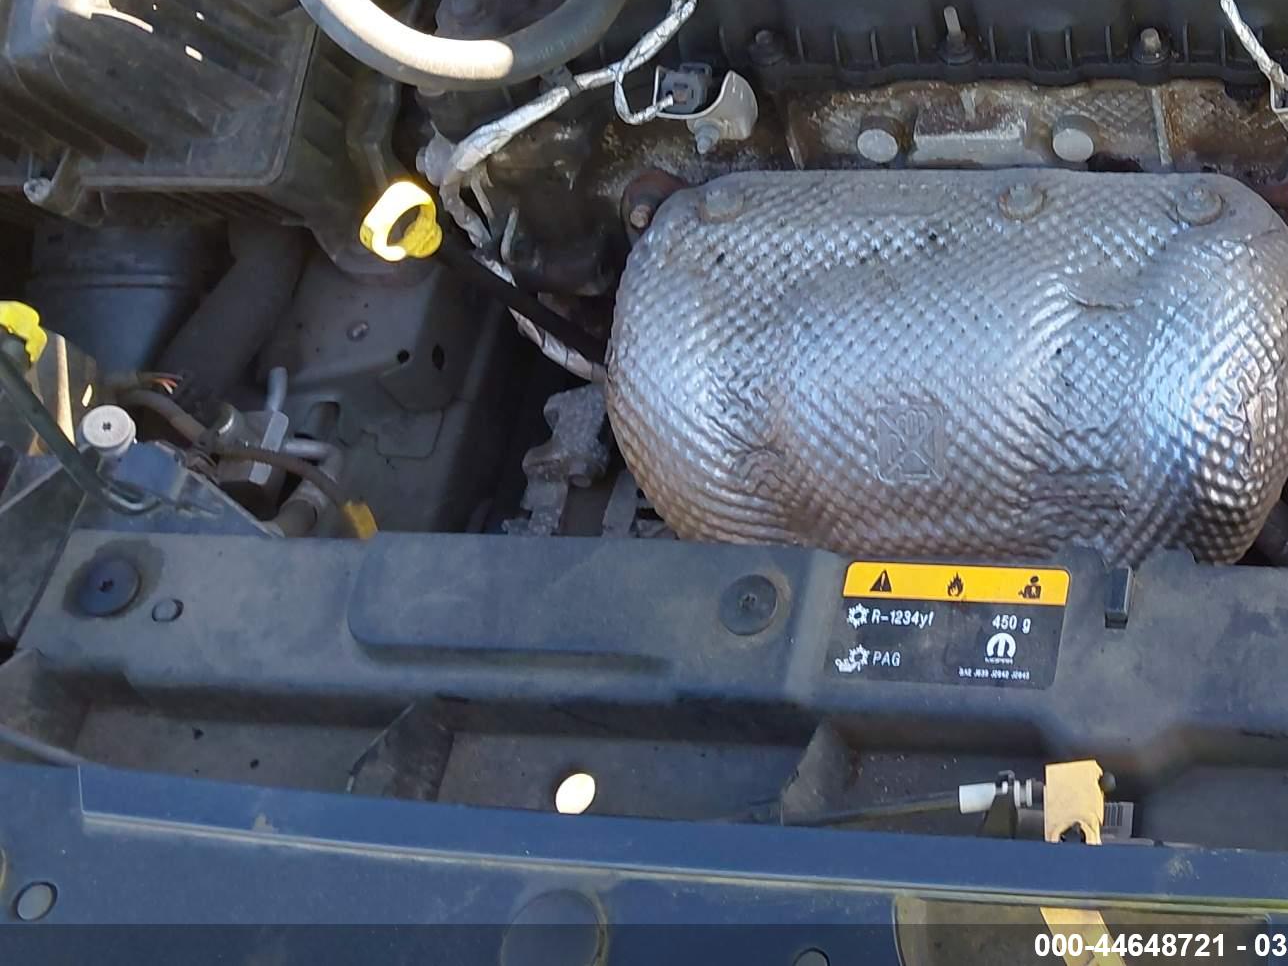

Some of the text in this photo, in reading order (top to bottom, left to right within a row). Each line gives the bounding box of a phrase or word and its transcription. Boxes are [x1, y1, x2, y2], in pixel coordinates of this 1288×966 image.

[992, 614, 1031, 634] 450 g
[872, 650, 901, 667] PAG
